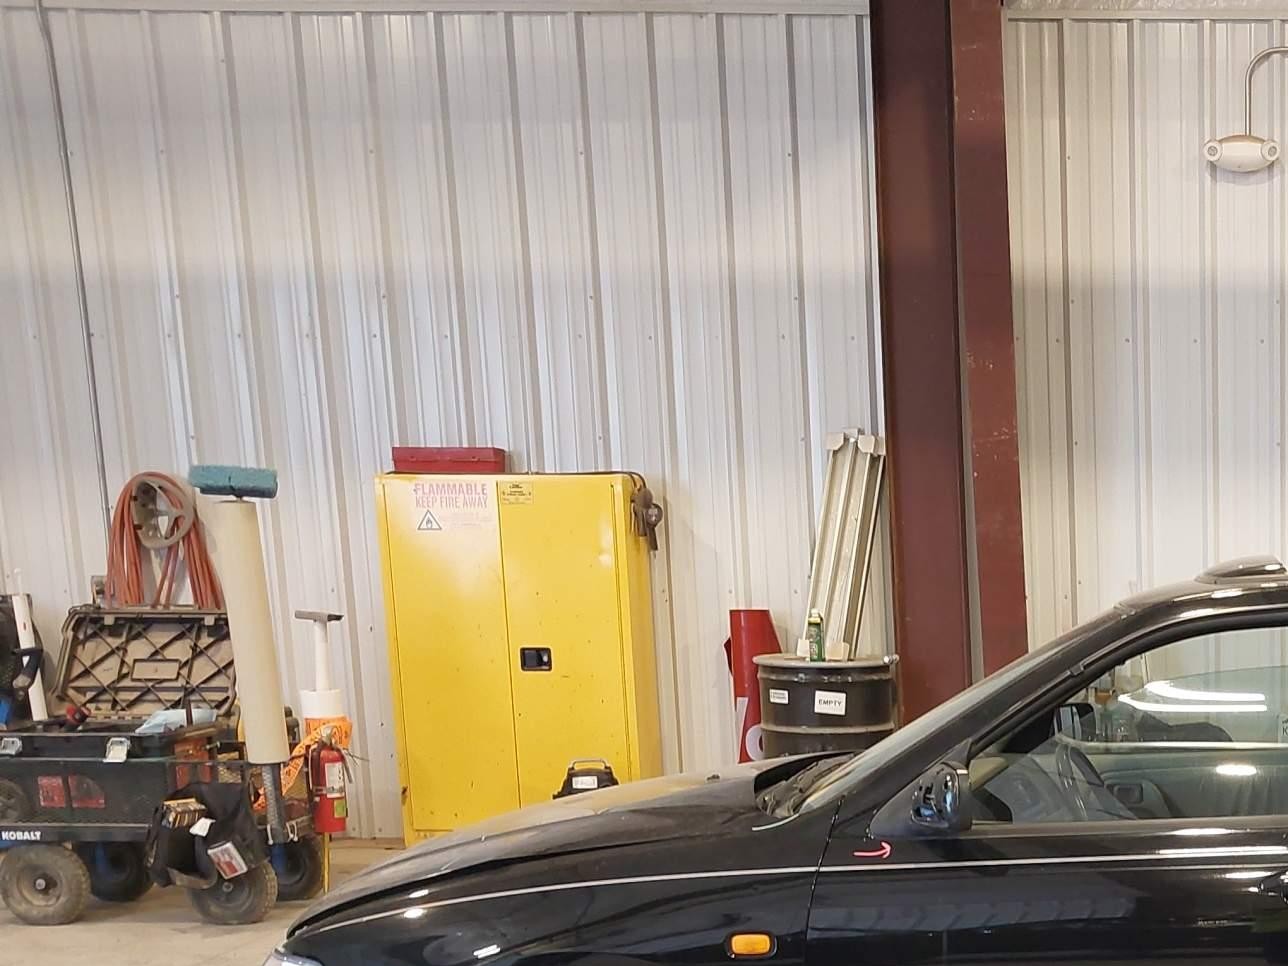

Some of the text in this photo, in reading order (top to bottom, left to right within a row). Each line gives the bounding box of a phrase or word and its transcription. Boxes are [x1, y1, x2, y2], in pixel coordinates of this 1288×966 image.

[414, 483, 488, 496] FLAMMABLE
[415, 496, 488, 509] KEEP FIRE AWAY
[818, 699, 842, 707] EMPTY
[1, 830, 41, 841] KOBALT
